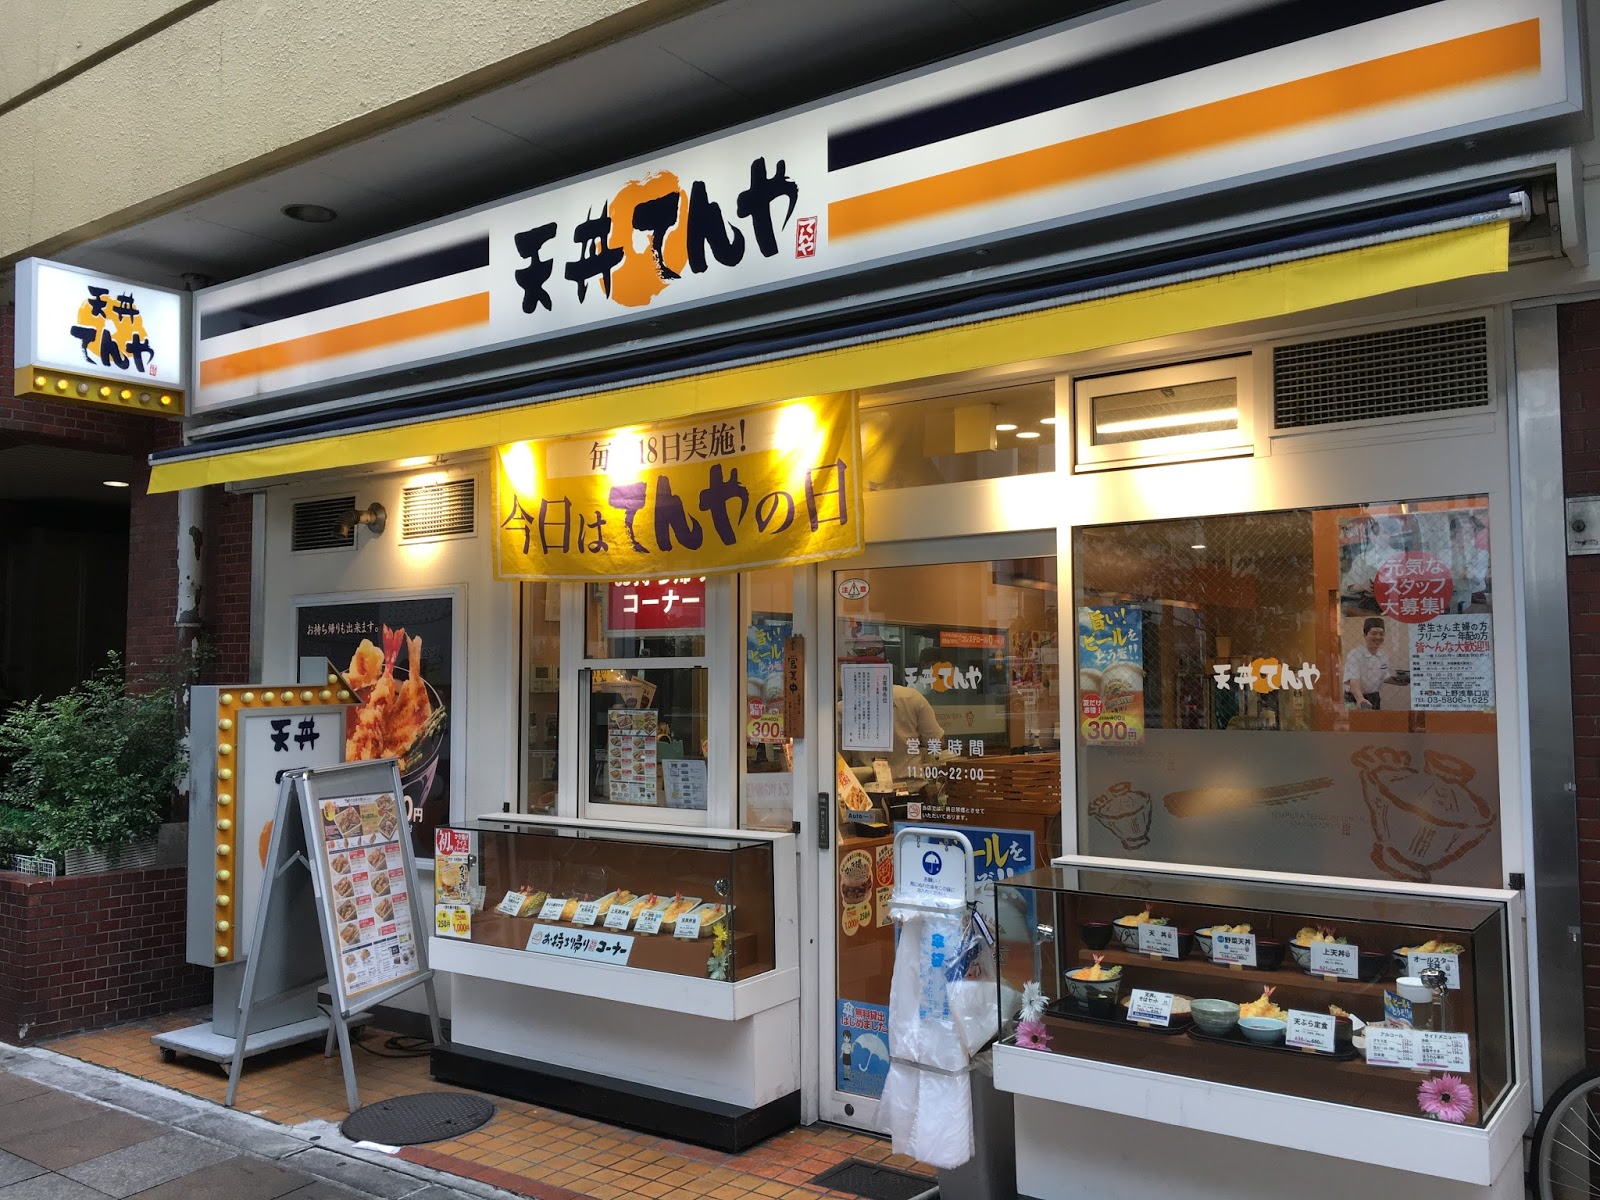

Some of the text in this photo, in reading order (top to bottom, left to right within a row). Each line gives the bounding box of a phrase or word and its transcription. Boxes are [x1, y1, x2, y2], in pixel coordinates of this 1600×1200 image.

[87, 285, 140, 324] 天丼
[70, 325, 155, 373] てんや
[589, 418, 746, 472] 毎18日実施!
[500, 457, 848, 556] 今日はてんやの日
[1384, 557, 1445, 577] 元気な
[1384, 577, 1446, 596] スタッフ
[623, 589, 700, 614] コーナー
[1380, 596, 1445, 616] 大募集!
[307, 620, 379, 636] お持ち帰りも出来ます。
[1417, 633, 1456, 641] フリーター
[1083, 628, 1139, 652] ビールを
[904, 665, 982, 690] 天丼てんや
[1212, 661, 1321, 690] 天丼てんや
[270, 715, 320, 752] 天丼
[906, 738, 984, 757] 営業時間
[596, 940, 628, 956] コーナー
[1323, 948, 1346, 957] 上天丼
[1413, 955, 1455, 964] オールスター
[842, 1001, 855, 1017] 傘
[1293, 1017, 1329, 1030] 天ぷら定食
